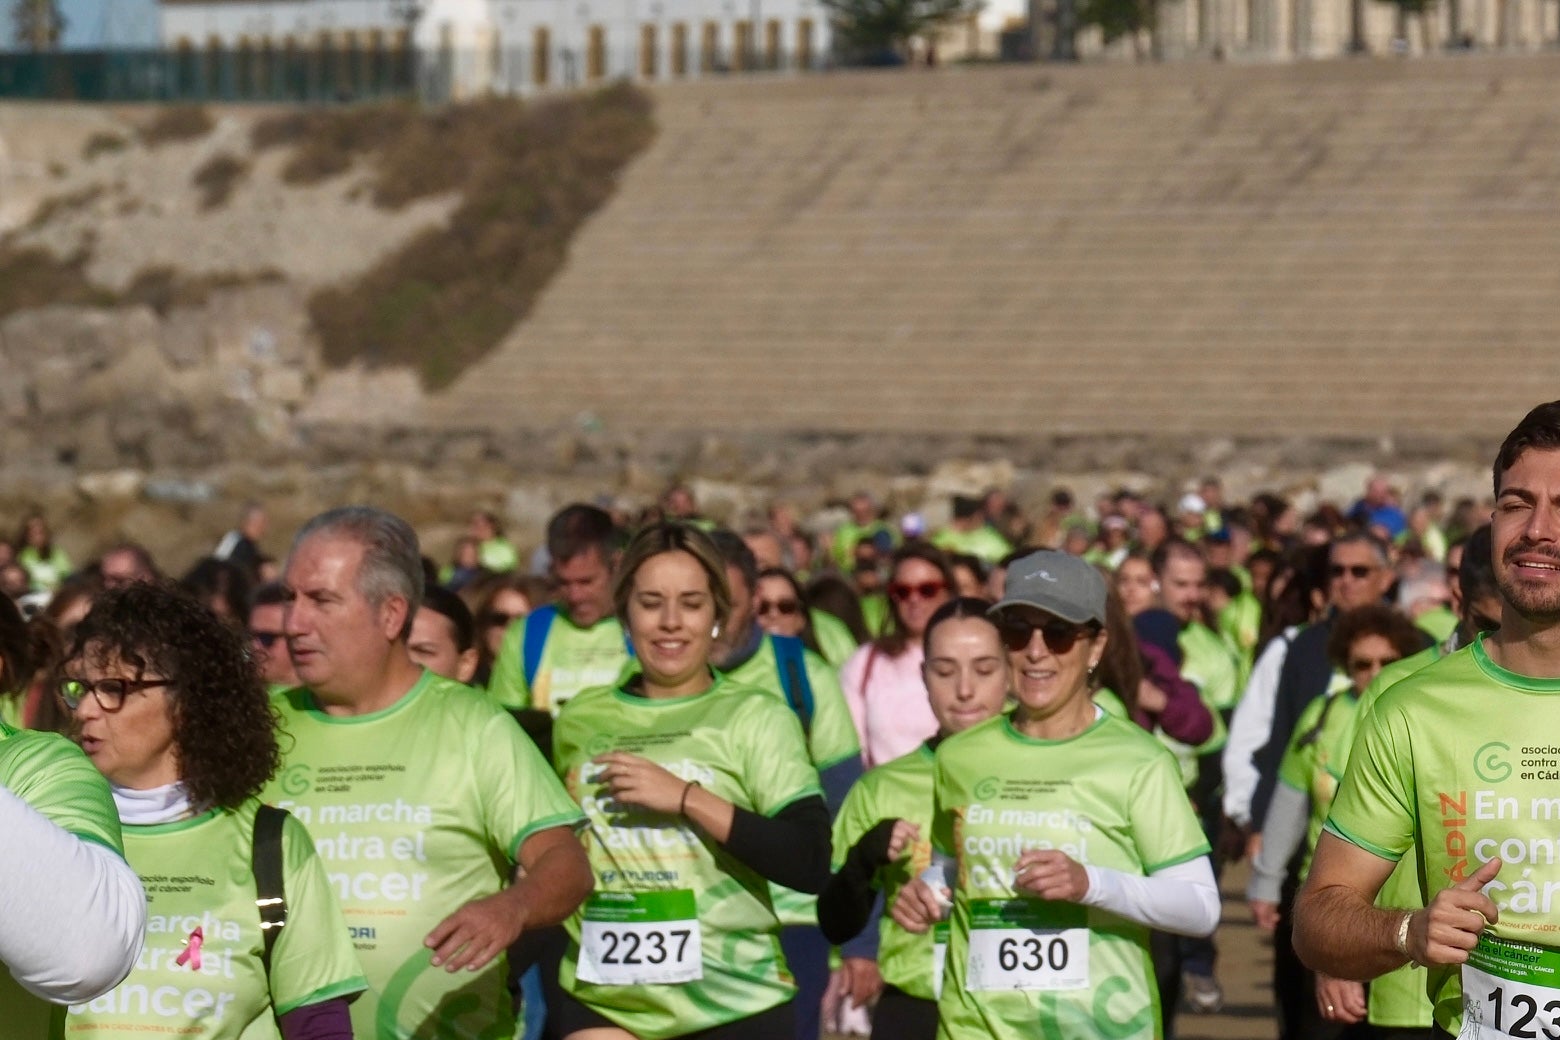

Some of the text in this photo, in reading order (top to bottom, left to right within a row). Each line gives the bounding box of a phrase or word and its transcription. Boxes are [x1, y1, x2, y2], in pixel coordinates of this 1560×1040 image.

[1520, 772, 1535, 780] en
[1521, 757, 1557, 768] contra
[319, 797, 432, 824] marcha
[966, 803, 1093, 833] En marcha
[1475, 790, 1519, 820] En
[316, 831, 427, 862] ntra el
[1439, 791, 1469, 882] ÁDIZ
[159, 885, 192, 893] cáncer
[170, 875, 215, 886] española
[328, 870, 429, 901] ncer
[147, 910, 241, 942] archa
[601, 929, 691, 965] 2237
[998, 938, 1069, 971] 630
[1504, 949, 1541, 963] cáncer
[138, 948, 235, 979] tra el
[68, 984, 236, 1020] ncer
